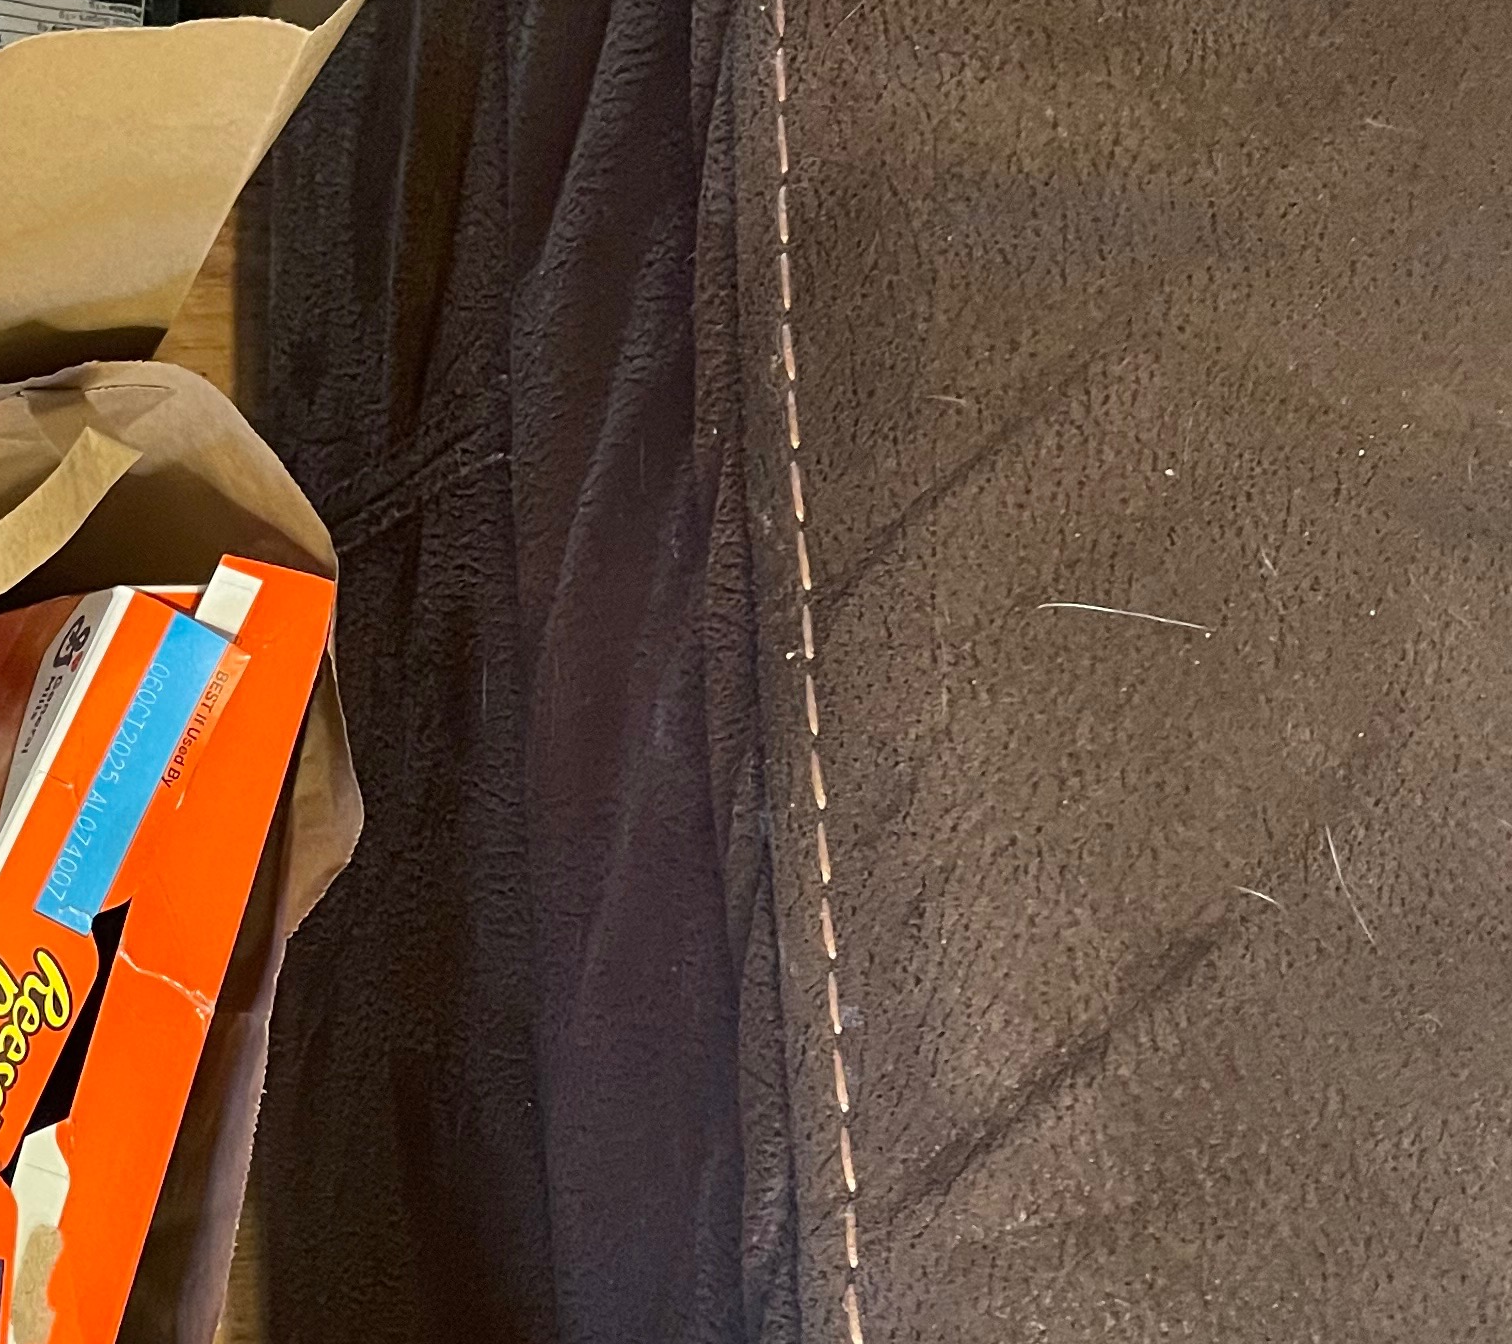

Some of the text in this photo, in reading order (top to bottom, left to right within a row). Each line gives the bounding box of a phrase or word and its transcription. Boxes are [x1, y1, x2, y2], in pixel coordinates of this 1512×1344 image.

[30, 674, 56, 722] Mills
[199, 669, 230, 713] BEST
[21, 674, 64, 756] General
[173, 726, 202, 767] Used
[159, 765, 182, 790] By
